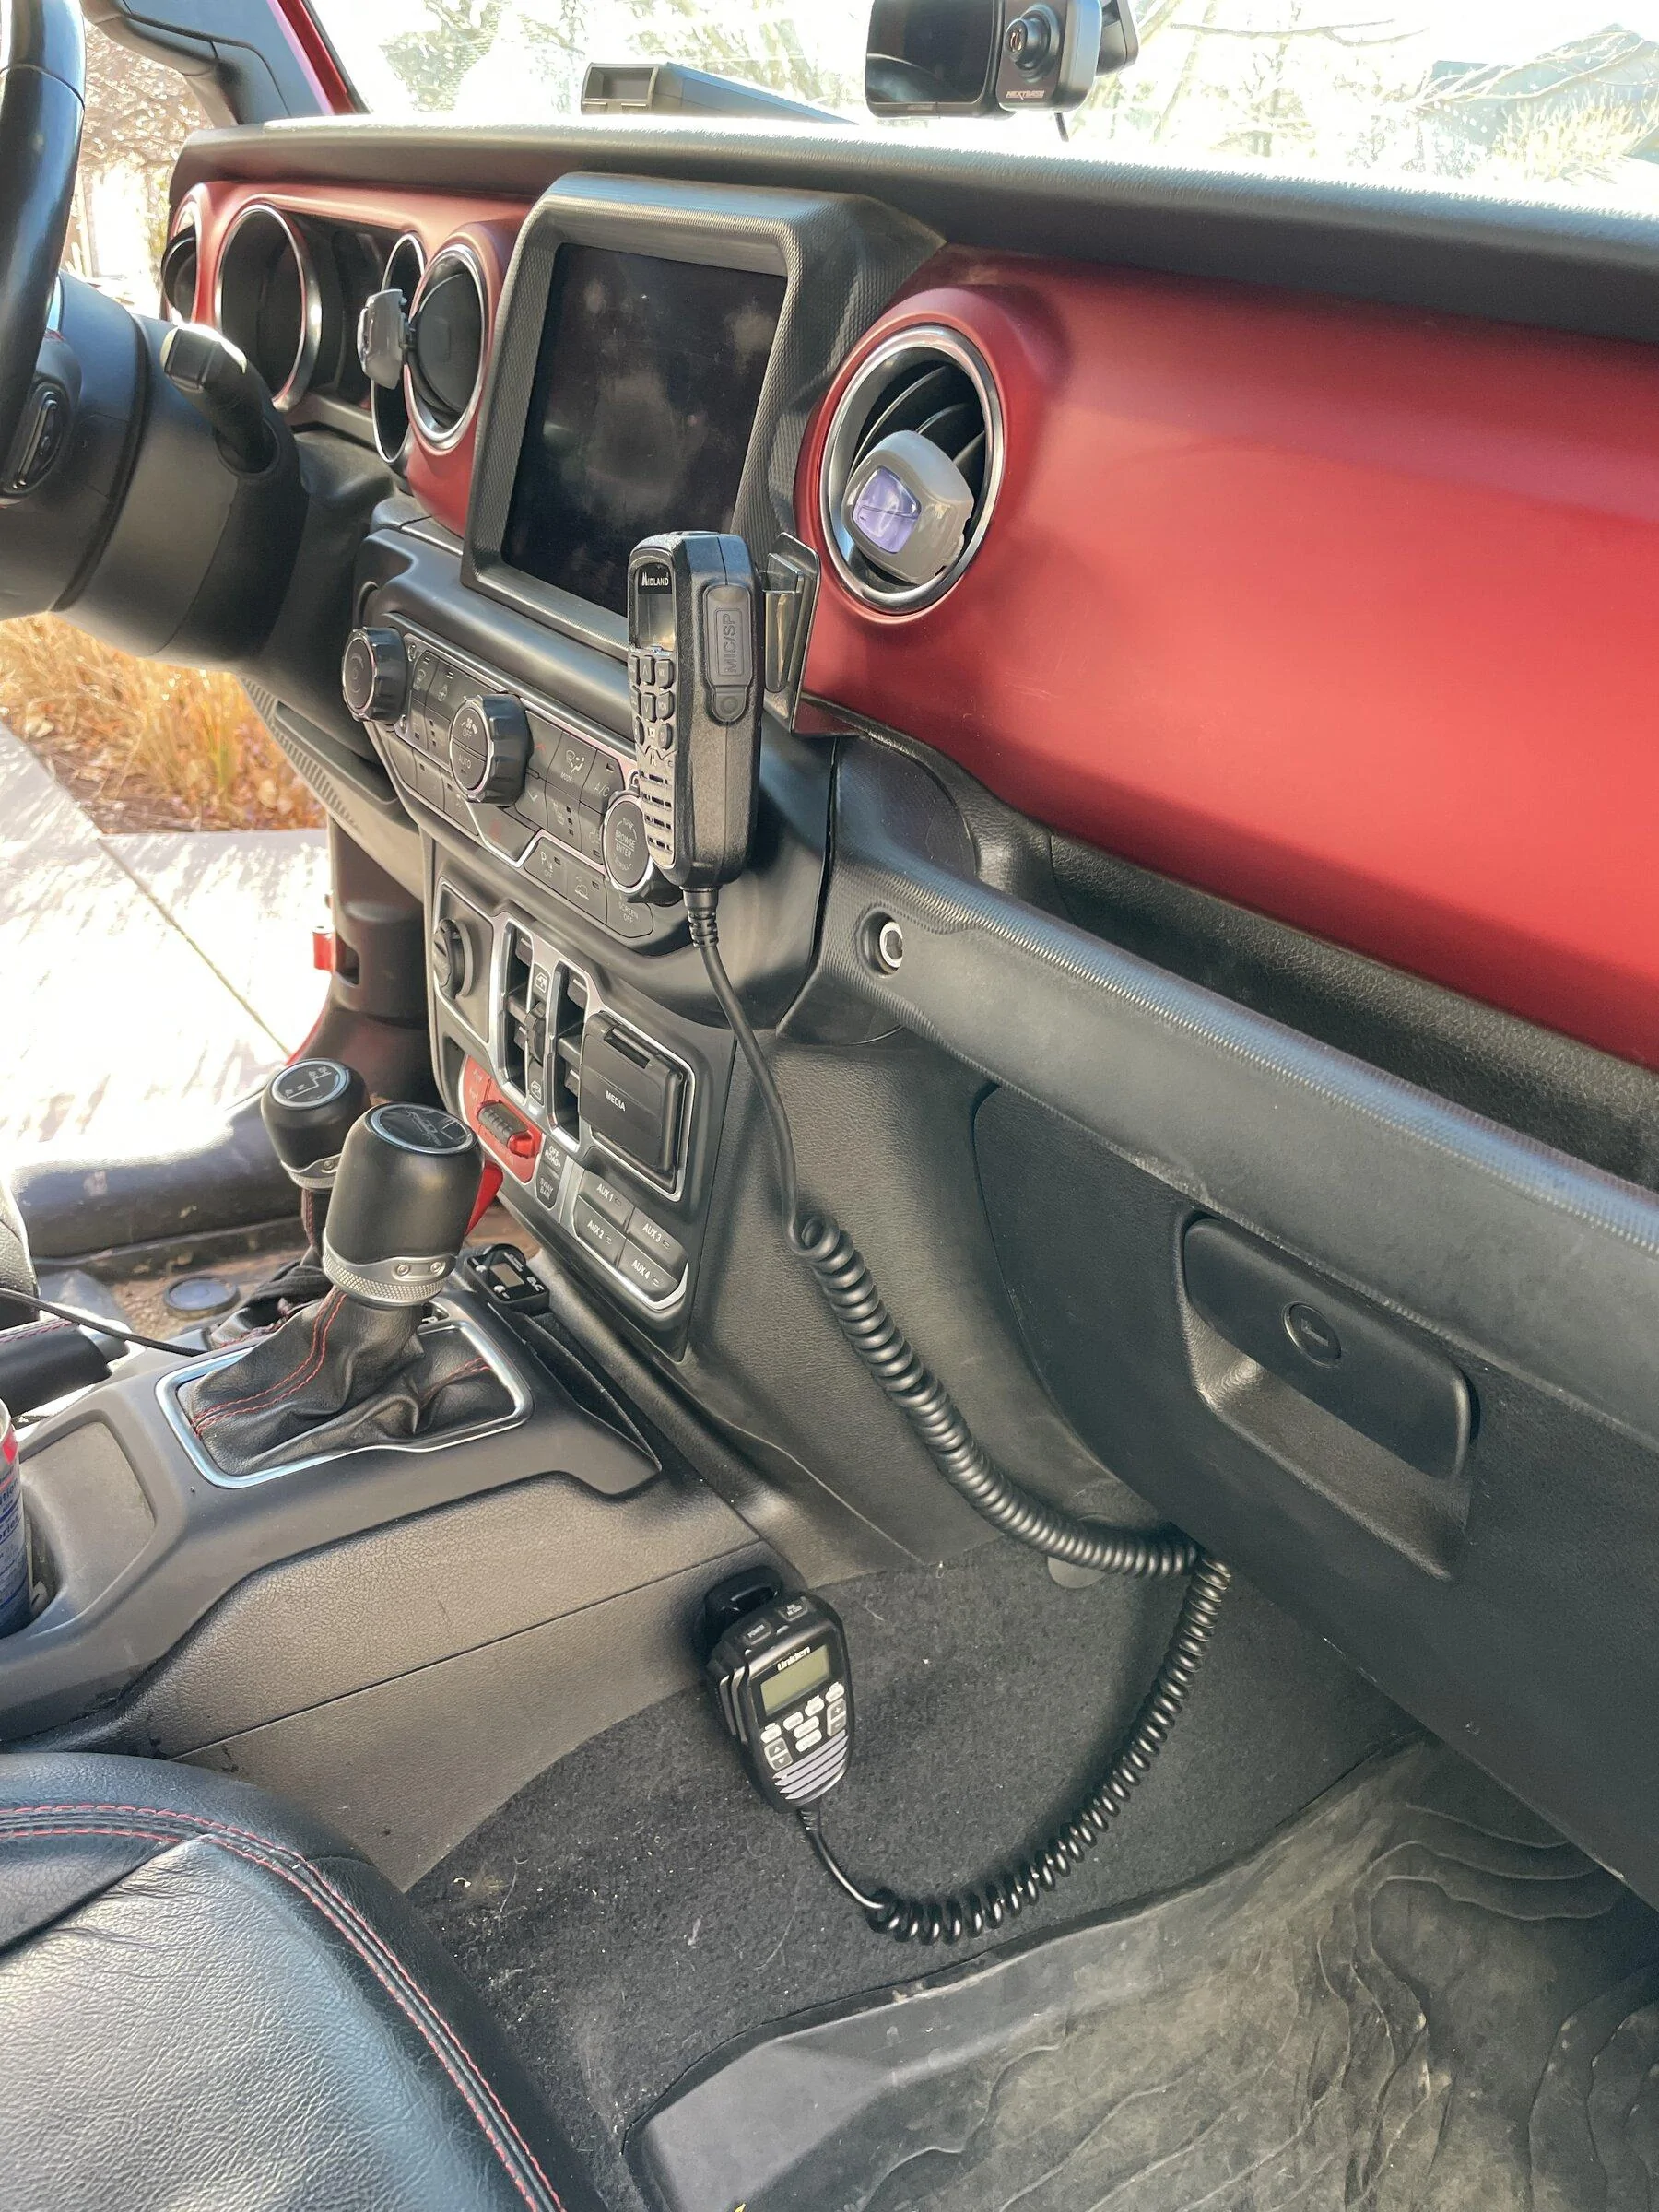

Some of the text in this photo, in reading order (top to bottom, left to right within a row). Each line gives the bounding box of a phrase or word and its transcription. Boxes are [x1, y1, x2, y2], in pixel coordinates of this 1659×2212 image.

[1006, 90, 1044, 100] NEXTBASE
[641, 571, 669, 586] MIDLAND
[723, 613, 737, 674] MIC/SP
[594, 782, 610, 797] A/C
[615, 829, 636, 848] BROWSE
[616, 842, 632, 858] ENTER
[605, 1089, 626, 1112] MEDIA
[596, 1183, 609, 1199] AUX
[587, 1219, 600, 1235] AUX
[642, 1223, 657, 1239] AUX
[631, 1259, 645, 1275] AUX
[777, 1646, 811, 1671] Uniden
